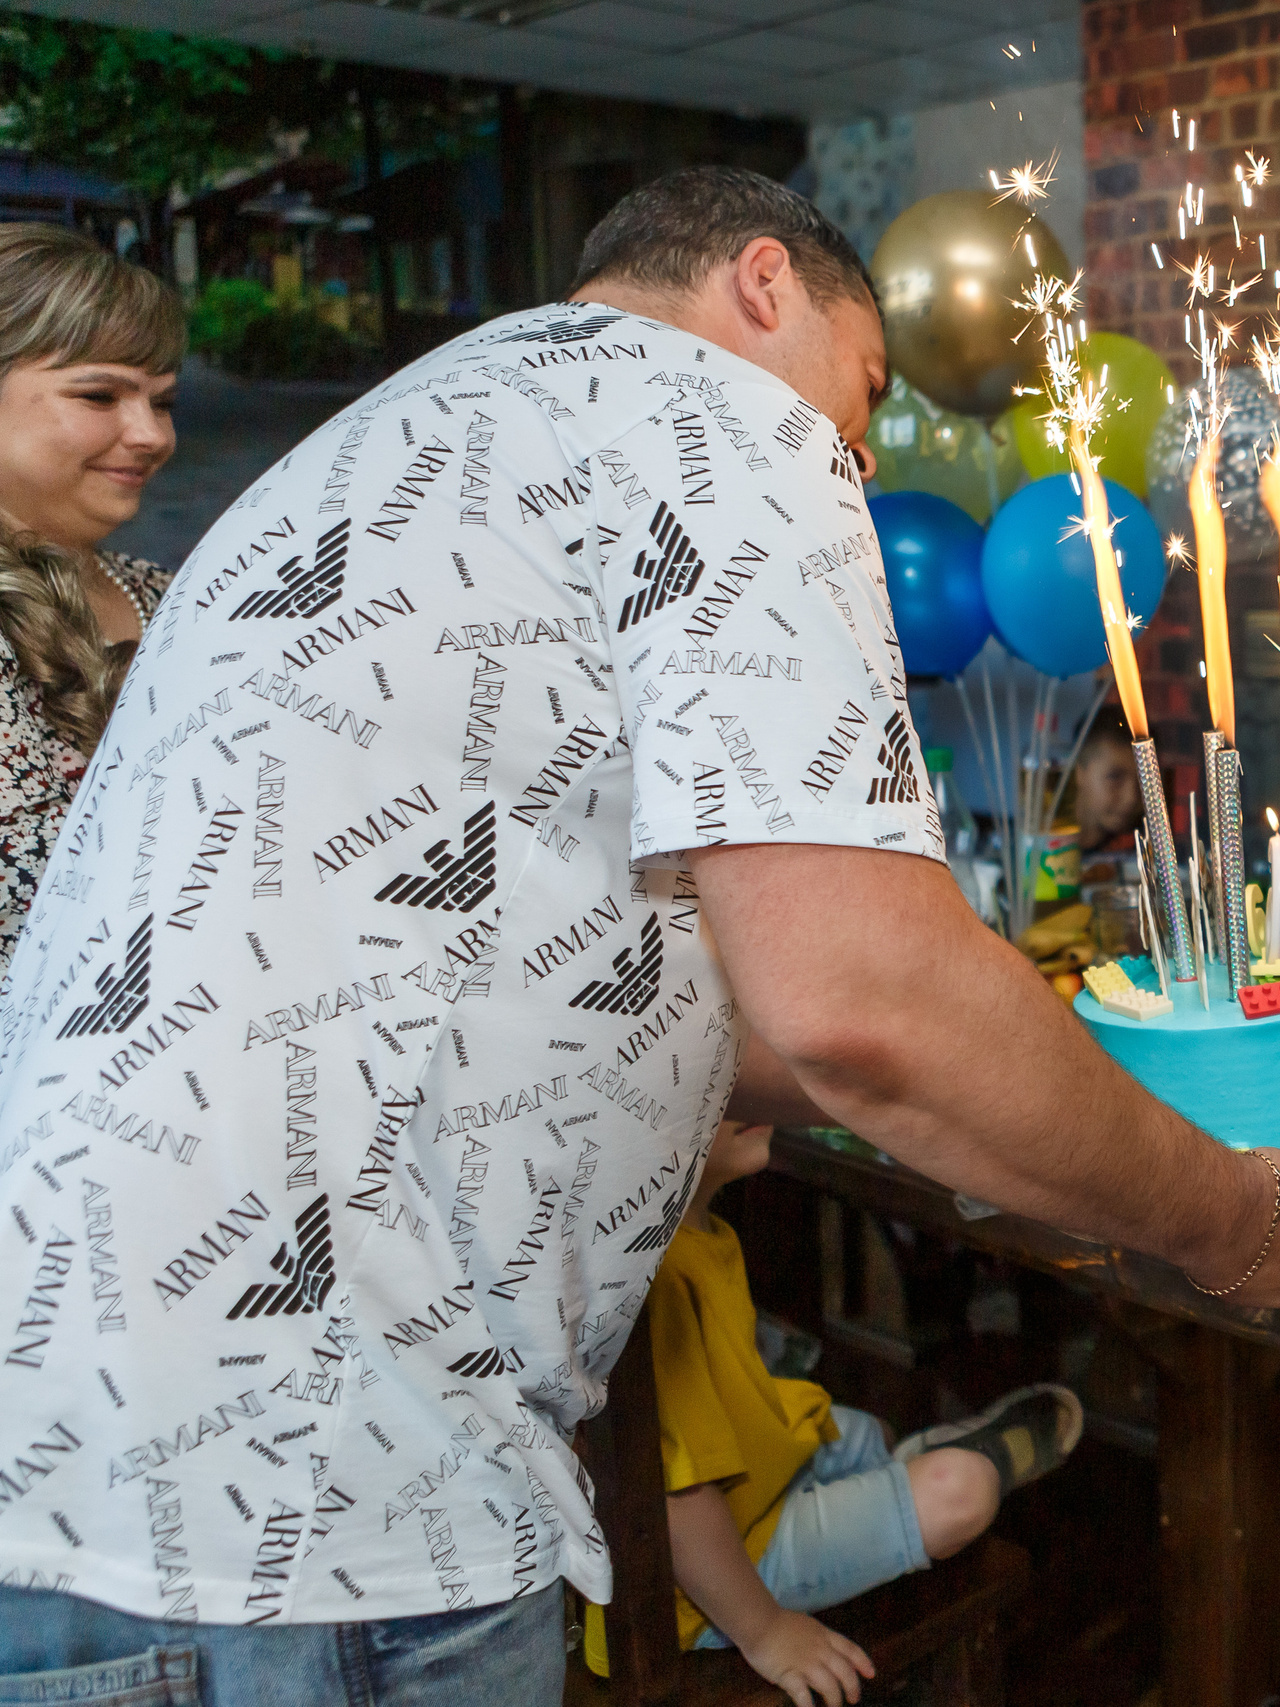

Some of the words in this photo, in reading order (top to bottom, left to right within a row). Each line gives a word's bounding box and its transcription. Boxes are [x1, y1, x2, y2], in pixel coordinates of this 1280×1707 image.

[515, 344, 648, 371] ARMANI
[318, 413, 376, 515] ARMANI
[365, 434, 455, 543] ARMANI
[460, 409, 498, 527] ARMANI
[671, 406, 716, 507] ARMANI
[762, 494, 795, 525] ARMANI
[194, 515, 299, 623] ARMANI
[451, 551, 475, 589] ARMANI
[683, 539, 770, 650] ARMANI
[798, 533, 871, 587] ARMANI
[281, 586, 418, 681] ARMANI
[434, 617, 598, 654] ARMANI
[659, 649, 802, 681] ARMANI
[765, 607, 799, 638] ARMANI
[239, 667, 382, 750] ARMANI
[371, 662, 394, 701] ARMANI
[547, 686, 565, 724] ARMANI
[575, 657, 608, 692] ARMANI
[674, 688, 710, 718] ARMANI
[128, 687, 233, 792] ARMANI
[230, 720, 271, 742] ARMANI
[460, 652, 508, 792] ARMANI
[656, 719, 693, 737] ARMANI
[800, 699, 869, 804] ARMANI
[191, 777, 208, 814] ARMANI
[508, 713, 608, 829] ARMANI
[653, 758, 685, 786] ARMANI
[710, 713, 795, 835] ARMANI
[128, 772, 168, 911] ARMANI
[165, 794, 246, 933] ARMANI
[252, 750, 286, 899] ARMANI
[312, 783, 441, 885] ARMANI
[873, 831, 907, 846] ARMANI
[39, 916, 112, 1027] ARMANI
[246, 931, 273, 972] ARMANI
[359, 935, 403, 950] ARMANI
[523, 894, 624, 989] ARMANI
[99, 982, 222, 1102] ARMANI
[243, 973, 396, 1051] ARMANI
[395, 1015, 439, 1032] ARMANI
[452, 1028, 470, 1068] ARMANI
[614, 978, 699, 1075] ARMANI
[286, 1039, 318, 1191] ARMANI
[357, 1059, 379, 1099] ARMANI
[433, 1074, 569, 1144] ARMANI
[562, 1111, 599, 1128] ARMANI
[577, 1062, 668, 1131] ARMANI
[60, 1090, 202, 1166] ARMANI
[523, 1158, 538, 1195] ARMANI
[591, 1150, 681, 1246] ARMANI
[82, 1177, 127, 1334] ARMANI
[153, 1190, 271, 1312] ARMANI
[487, 1175, 563, 1303] ARMANI
[4, 1223, 77, 1370] ARMANI
[108, 1390, 266, 1489] ARMANI
[384, 1413, 485, 1533] ARMANI
